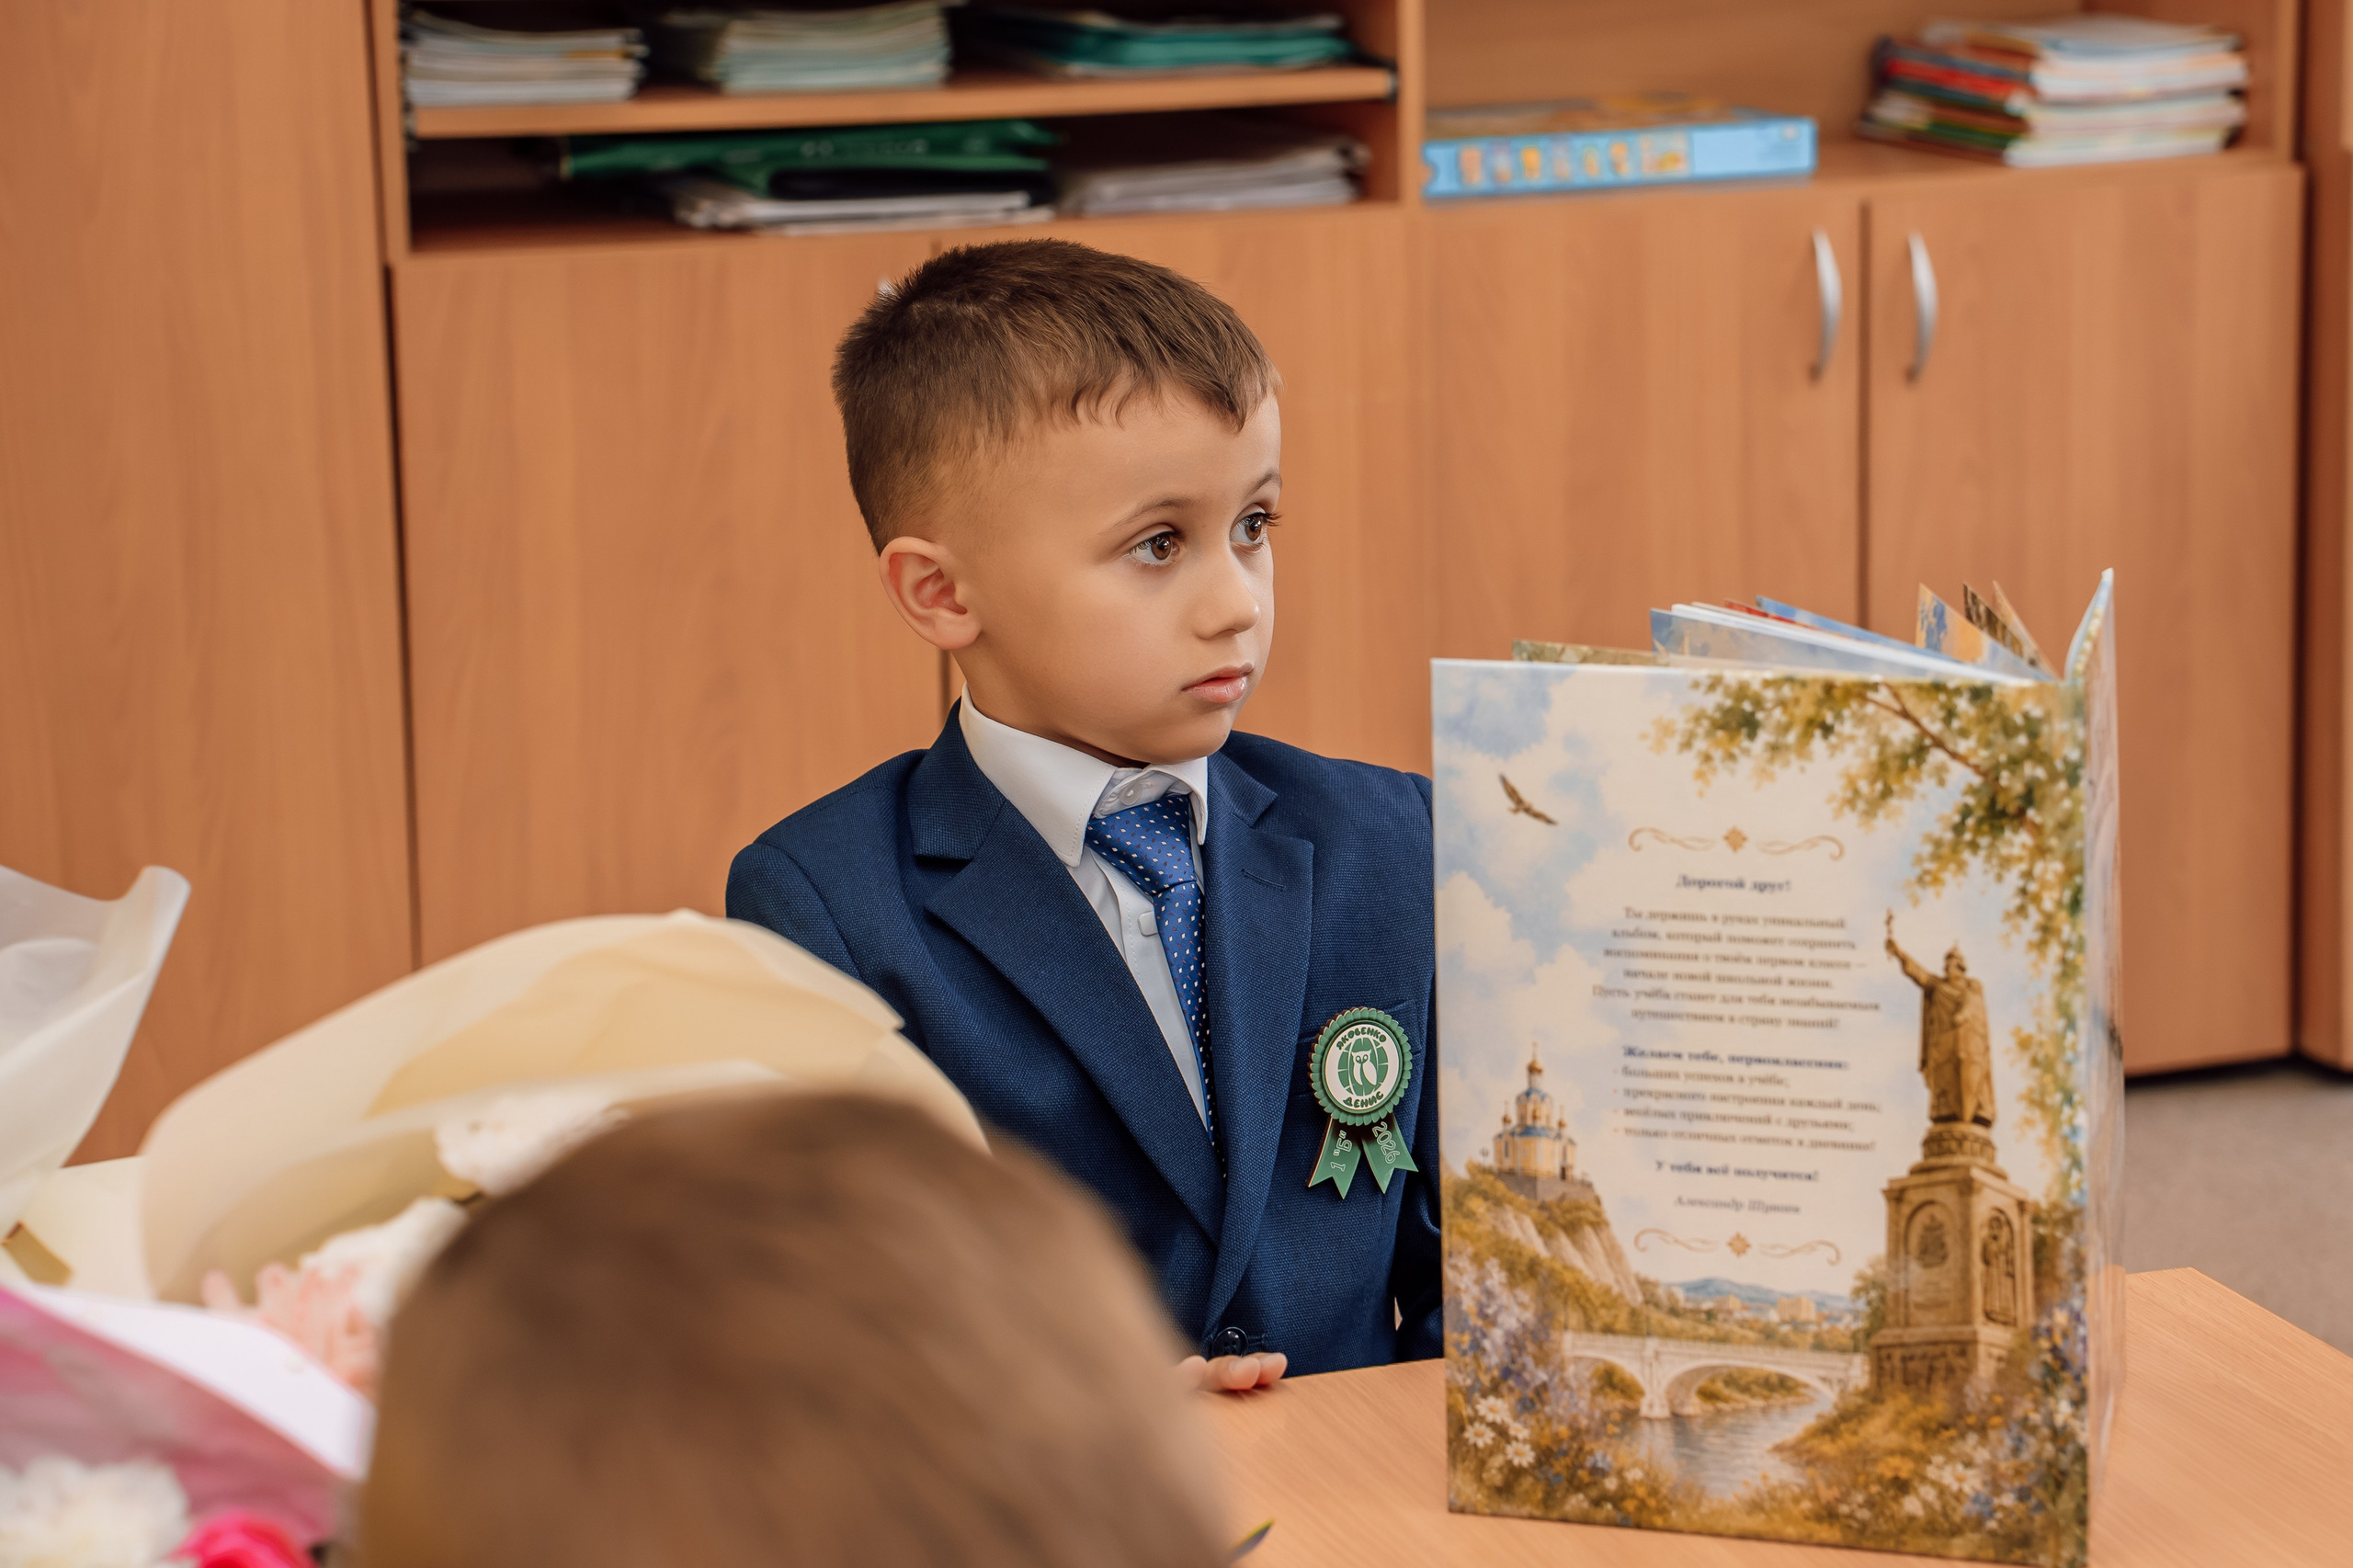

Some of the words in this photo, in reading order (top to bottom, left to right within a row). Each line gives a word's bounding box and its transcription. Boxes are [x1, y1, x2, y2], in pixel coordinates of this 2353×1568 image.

[1676, 874, 1745, 891] Дорогой
[1750, 880, 1791, 893] друг!
[1623, 906, 1643, 918] Ты
[1665, 931, 1722, 943] который
[1336, 1027, 1387, 1051] ЯКОВЕНКО
[1622, 1045, 1683, 1060] Желаем
[1343, 1091, 1384, 1108] ДЕНИС
[1372, 1120, 1401, 1165] 2026
[1331, 1161, 1346, 1172] 1
[1674, 1196, 1744, 1212] Александр
